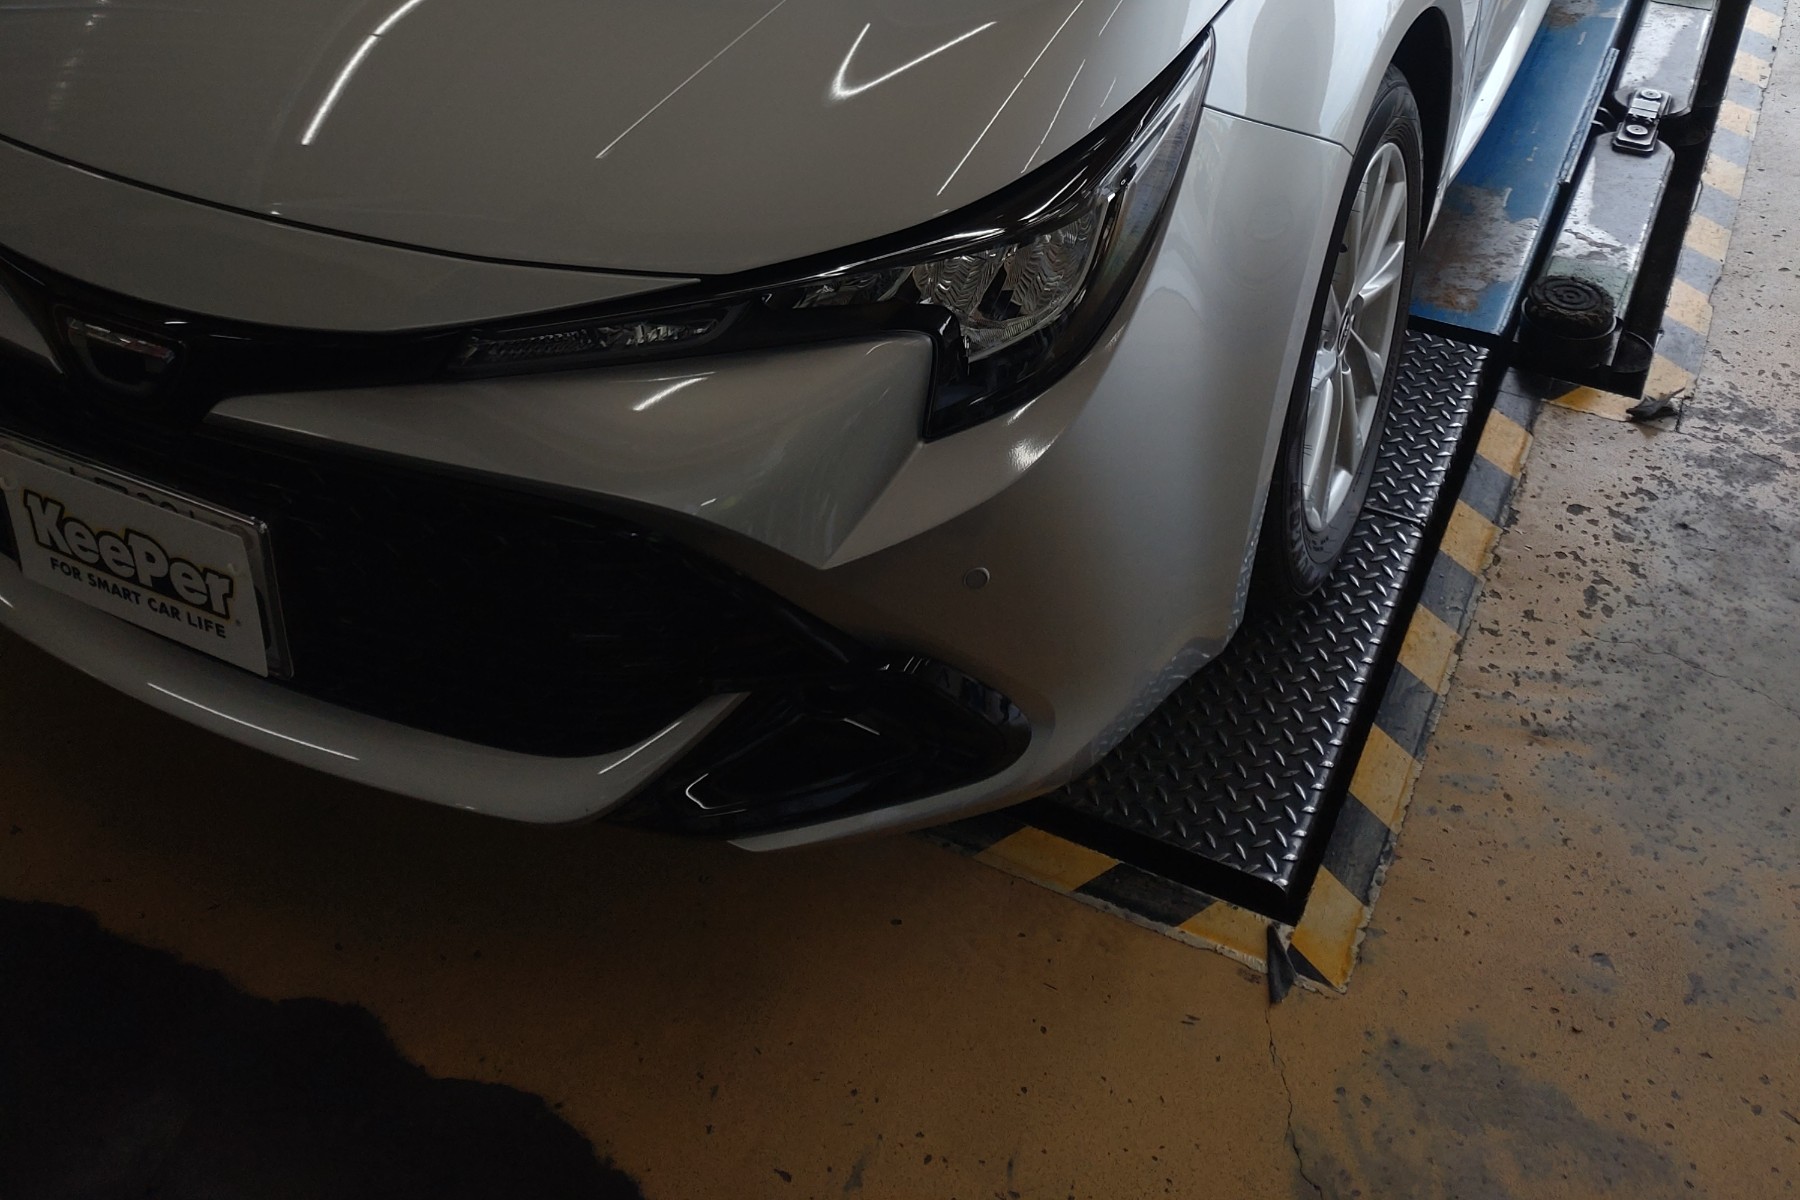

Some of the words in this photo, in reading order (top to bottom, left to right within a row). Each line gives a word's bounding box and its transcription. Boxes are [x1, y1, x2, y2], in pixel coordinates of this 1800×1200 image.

[23, 488, 235, 620] KeePer
[51, 557, 82, 582] FOR
[88, 574, 141, 606] SMART
[147, 597, 181, 621] CAR
[187, 614, 227, 639] LIFE
